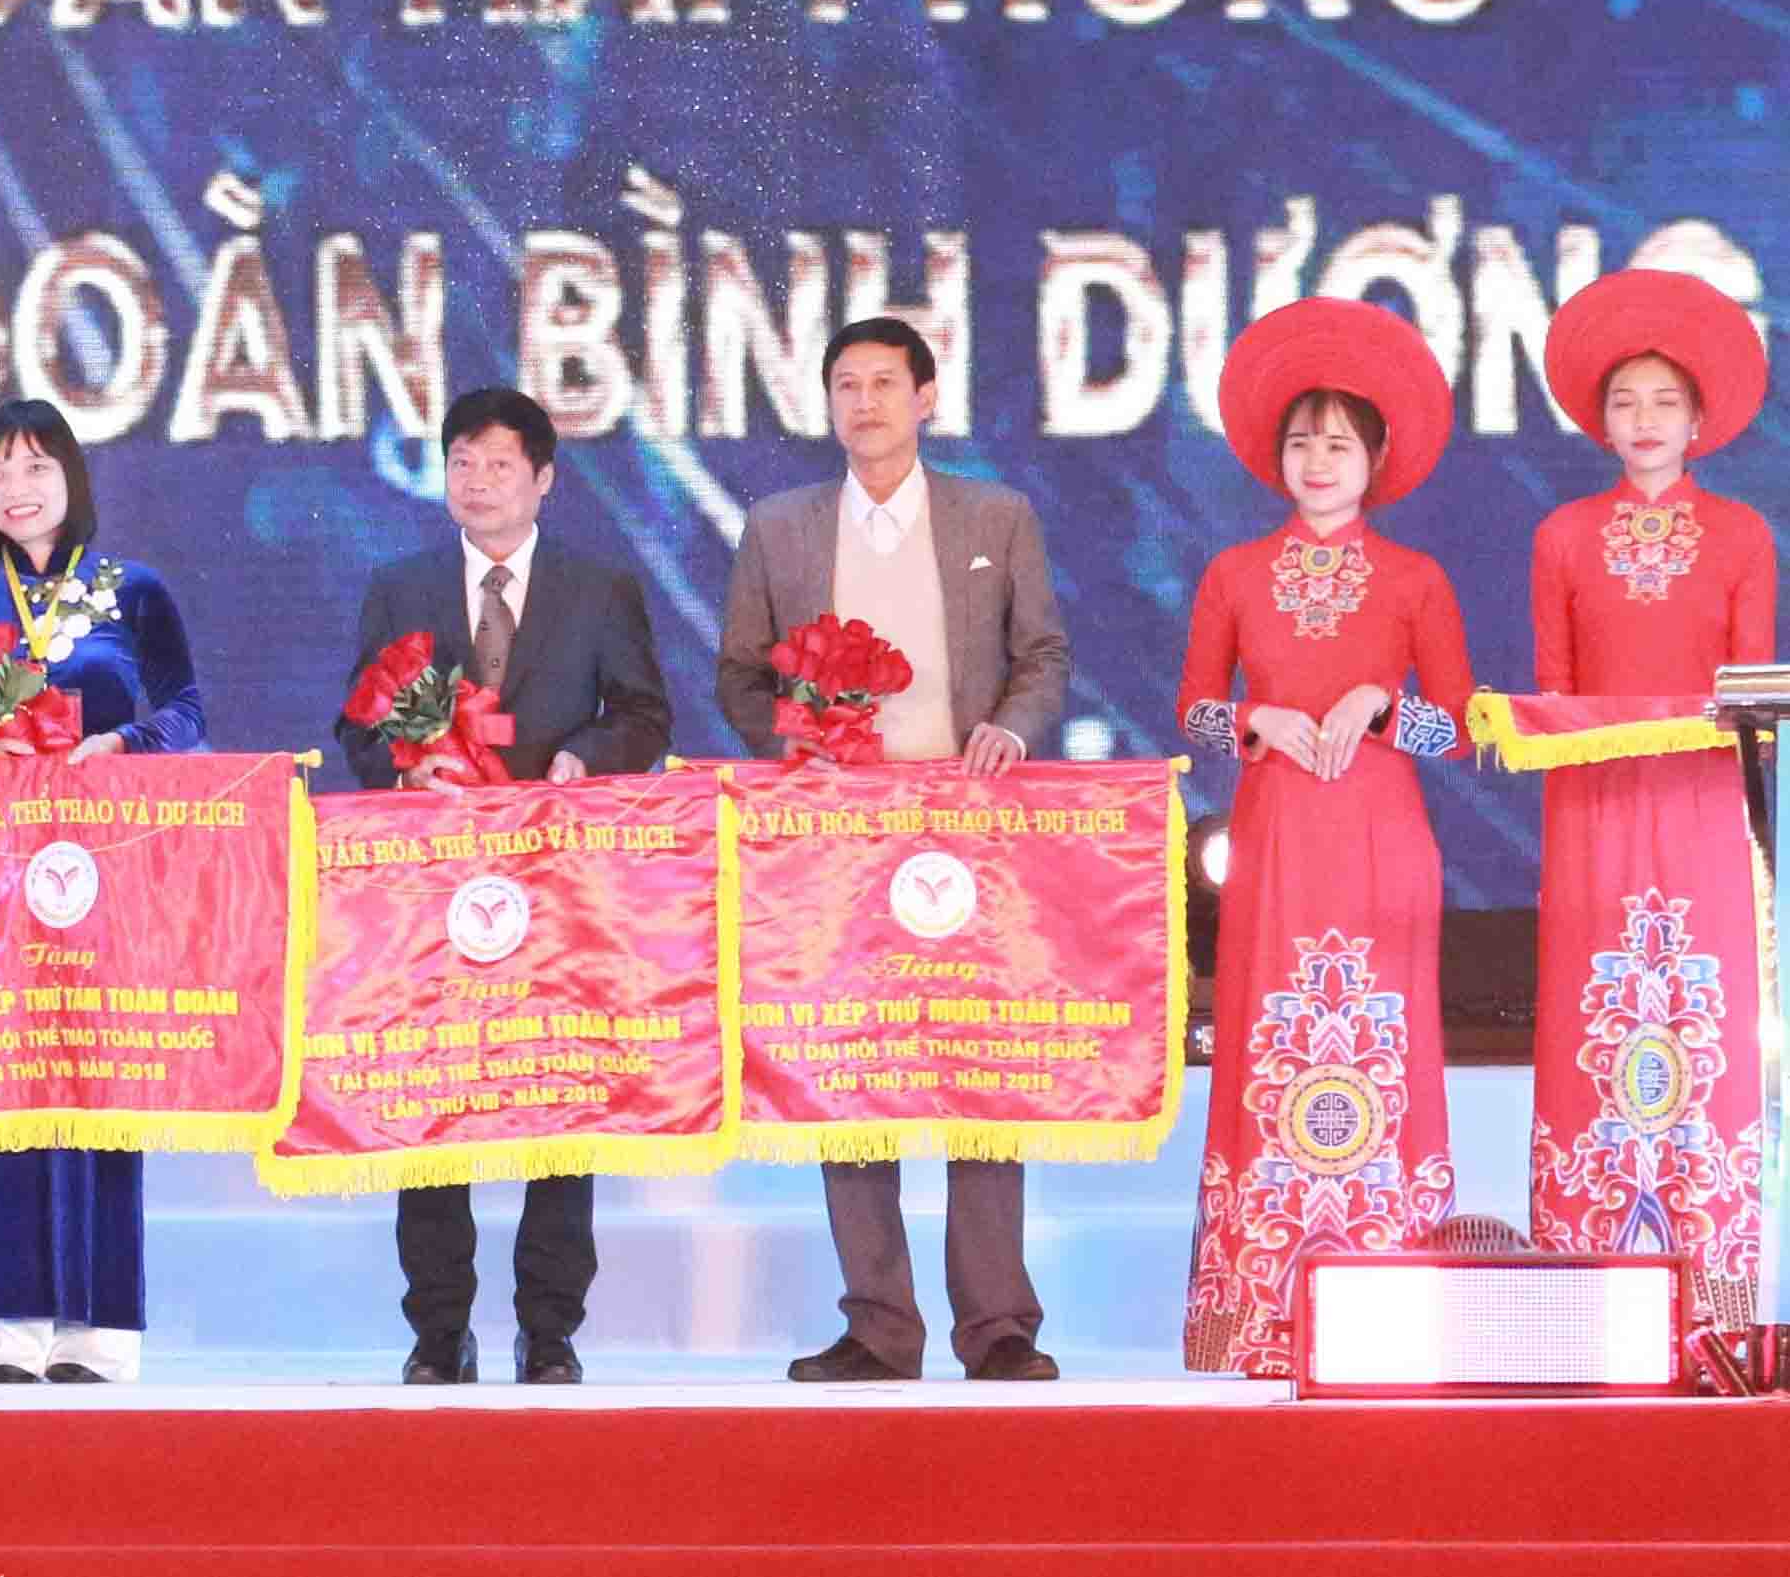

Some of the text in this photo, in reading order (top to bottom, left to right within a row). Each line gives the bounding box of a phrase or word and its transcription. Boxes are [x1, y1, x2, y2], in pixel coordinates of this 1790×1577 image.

[520, 190, 976, 444] BÌNH
[56, 801, 115, 824] THAO
[156, 802, 187, 825] DU
